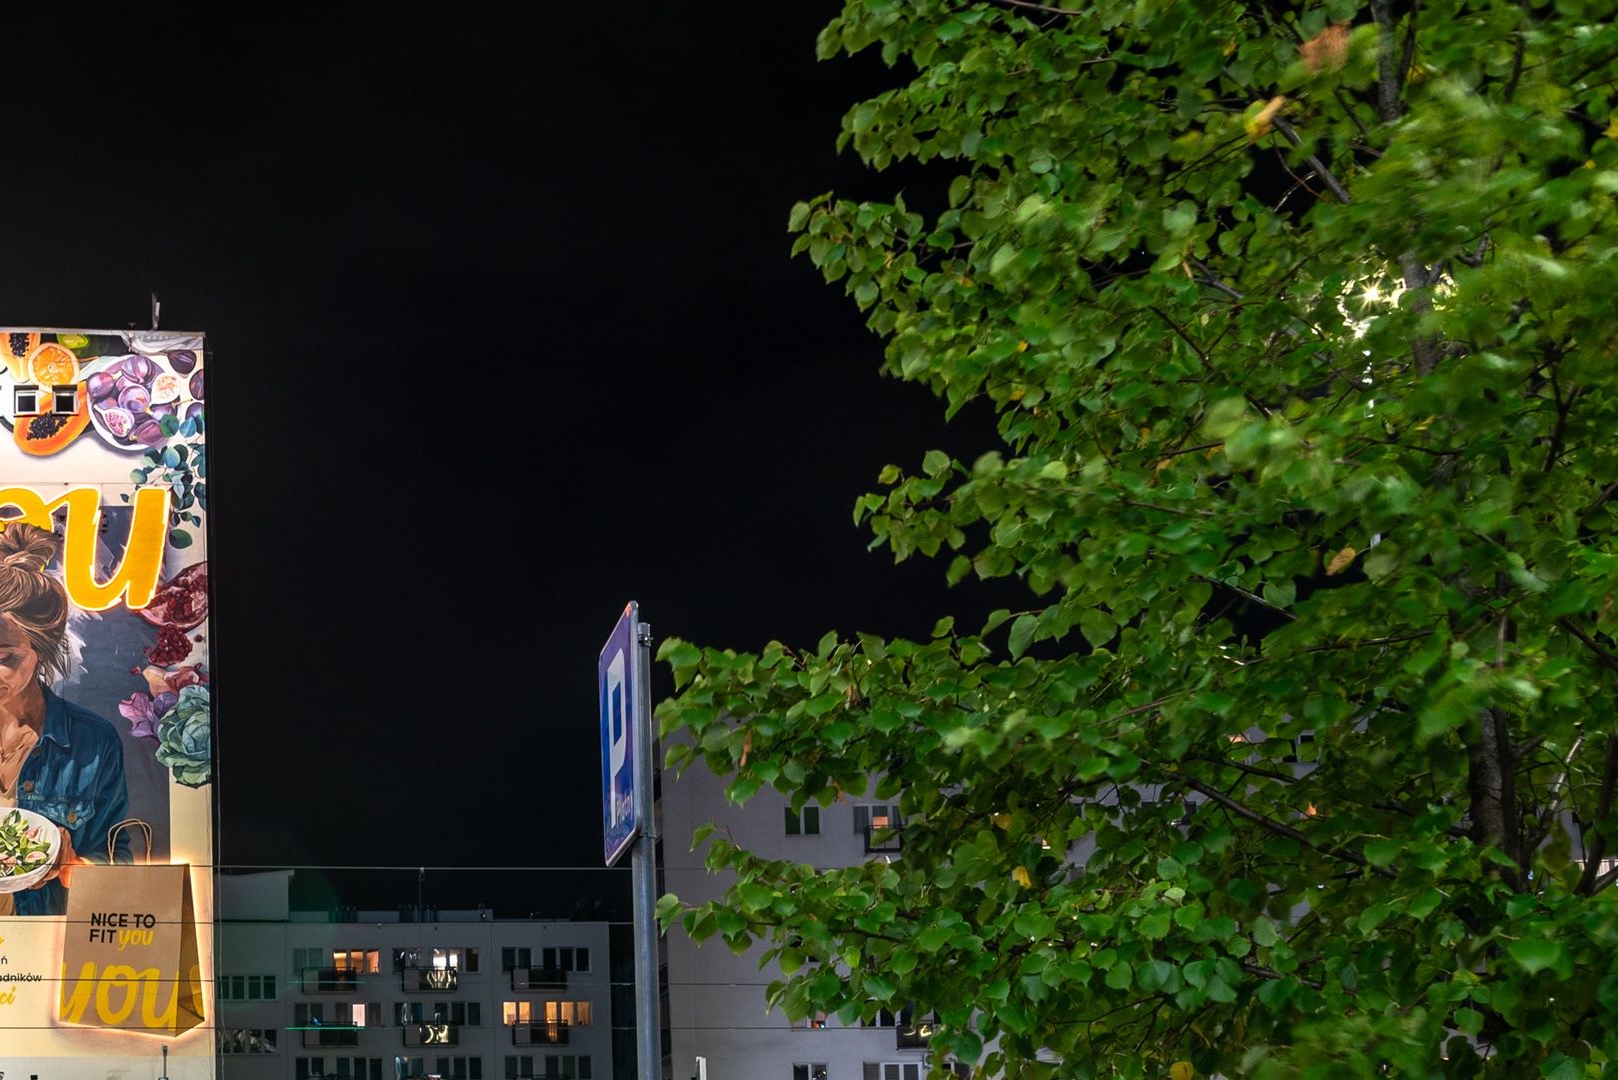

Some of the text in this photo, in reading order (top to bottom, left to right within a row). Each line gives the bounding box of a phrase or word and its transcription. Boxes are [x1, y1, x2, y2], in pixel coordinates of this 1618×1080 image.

[607, 648, 627, 830] P
[89, 929, 155, 952] FIT you
[90, 913, 156, 928] NICE TO
[60, 961, 180, 1032] you
